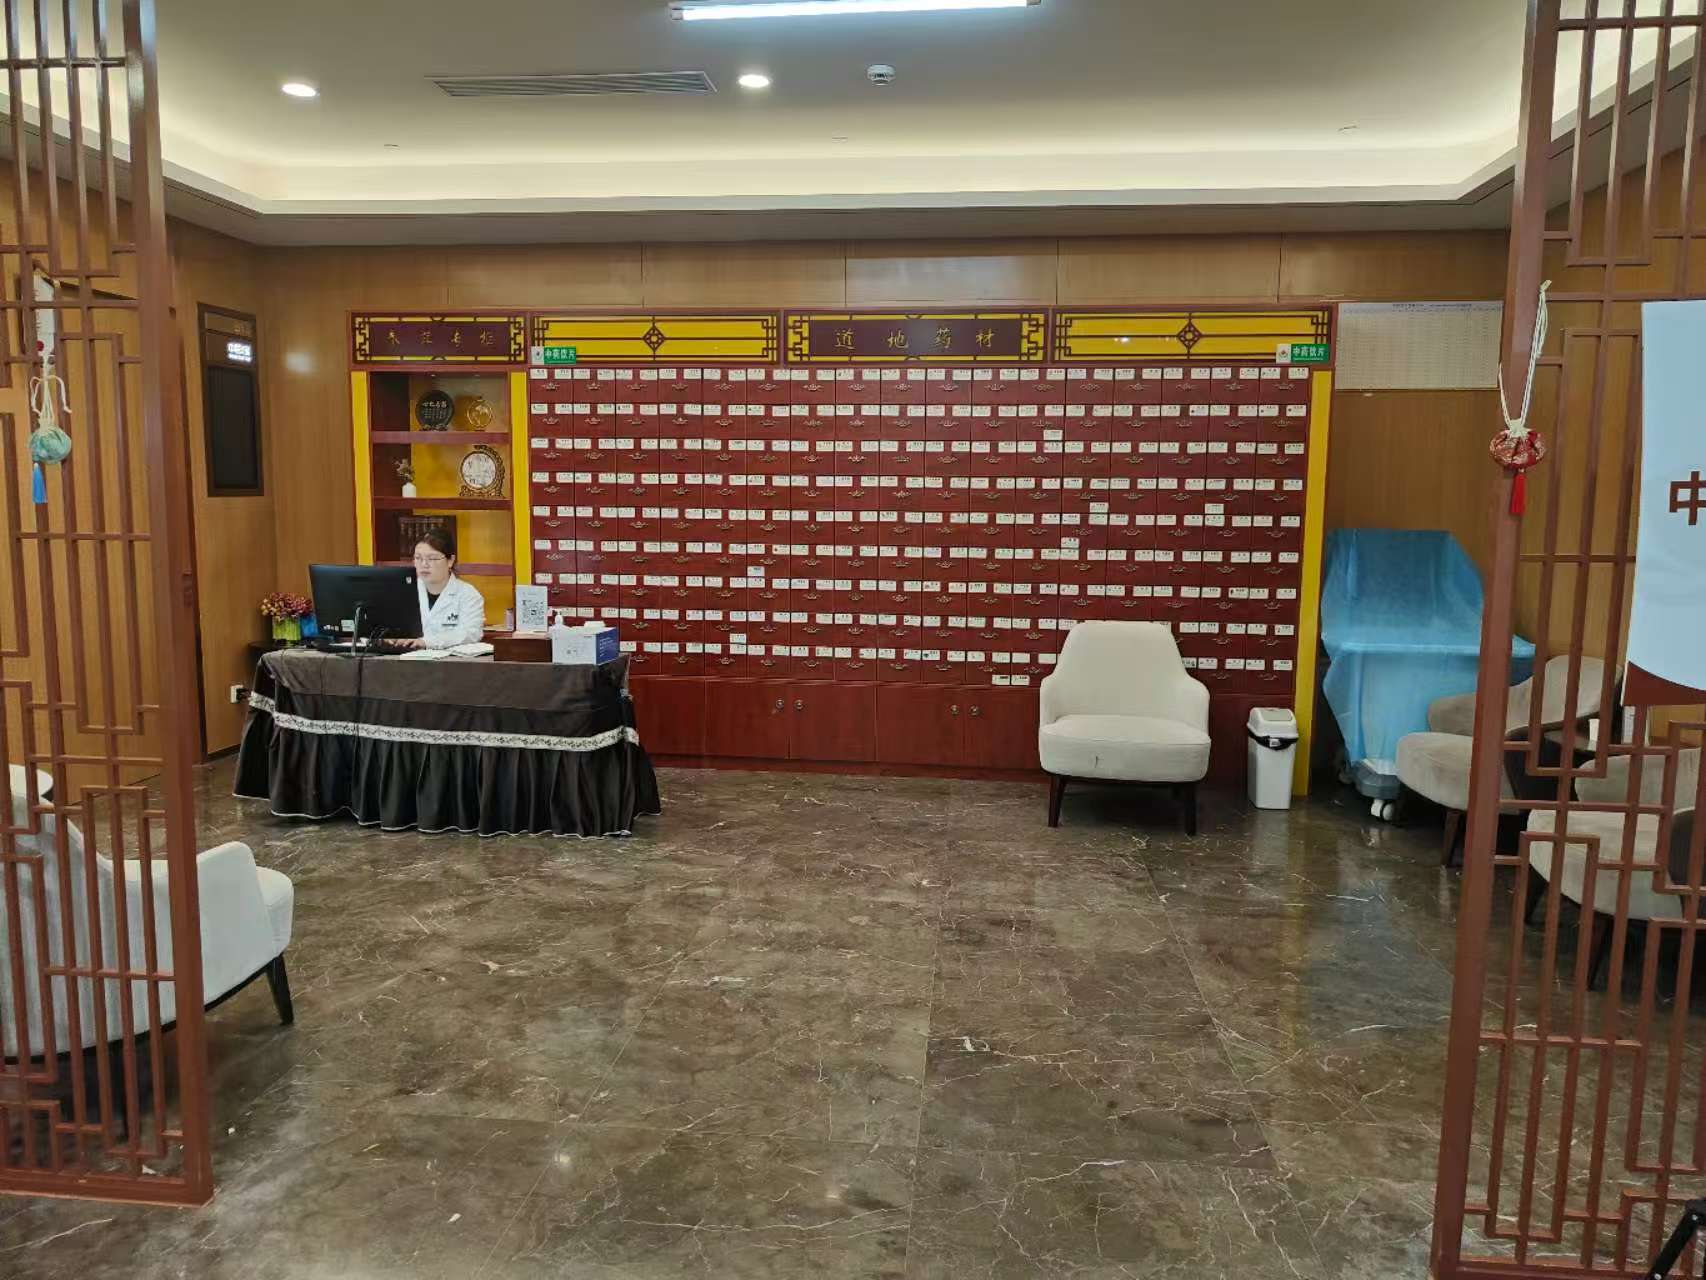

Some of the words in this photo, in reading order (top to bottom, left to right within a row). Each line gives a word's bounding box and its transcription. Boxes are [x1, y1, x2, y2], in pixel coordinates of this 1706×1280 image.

[834, 327, 996, 349] 道地药材
[545, 348, 576, 360] 中药饮片
[1292, 345, 1325, 357] 中药饮片
